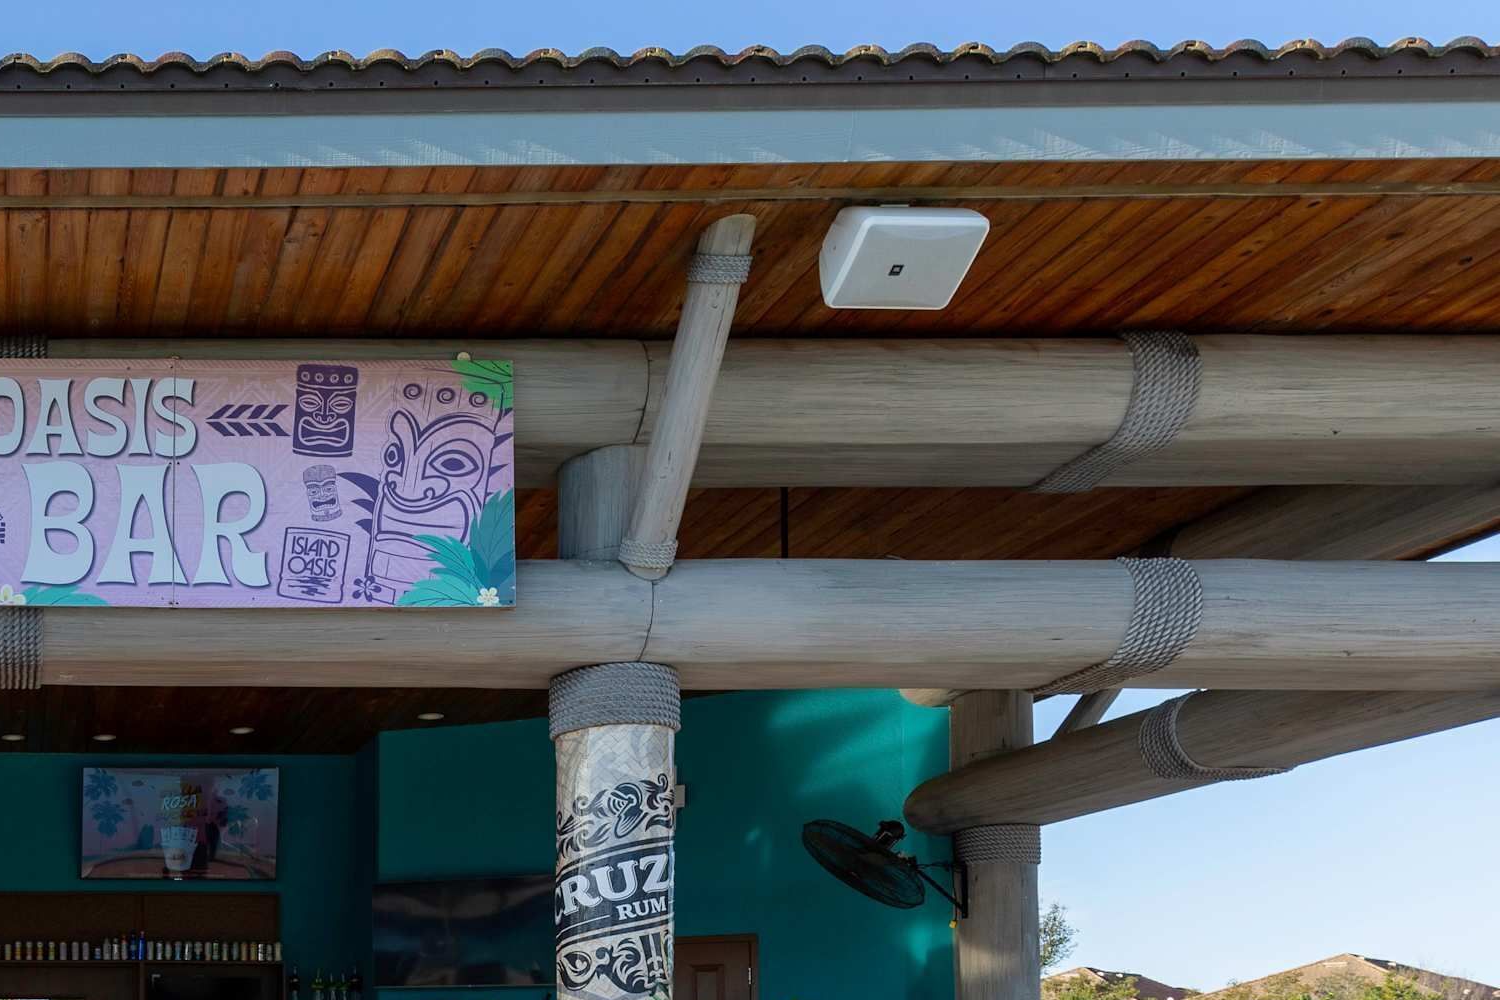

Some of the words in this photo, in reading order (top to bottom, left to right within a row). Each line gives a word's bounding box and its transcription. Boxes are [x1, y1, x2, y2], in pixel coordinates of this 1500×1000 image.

[20, 461, 271, 588] BAR
[291, 535, 340, 558] ISLAND
[287, 555, 337, 578] OASIS
[162, 794, 197, 811] ROSA
[616, 895, 667, 921] RUM
